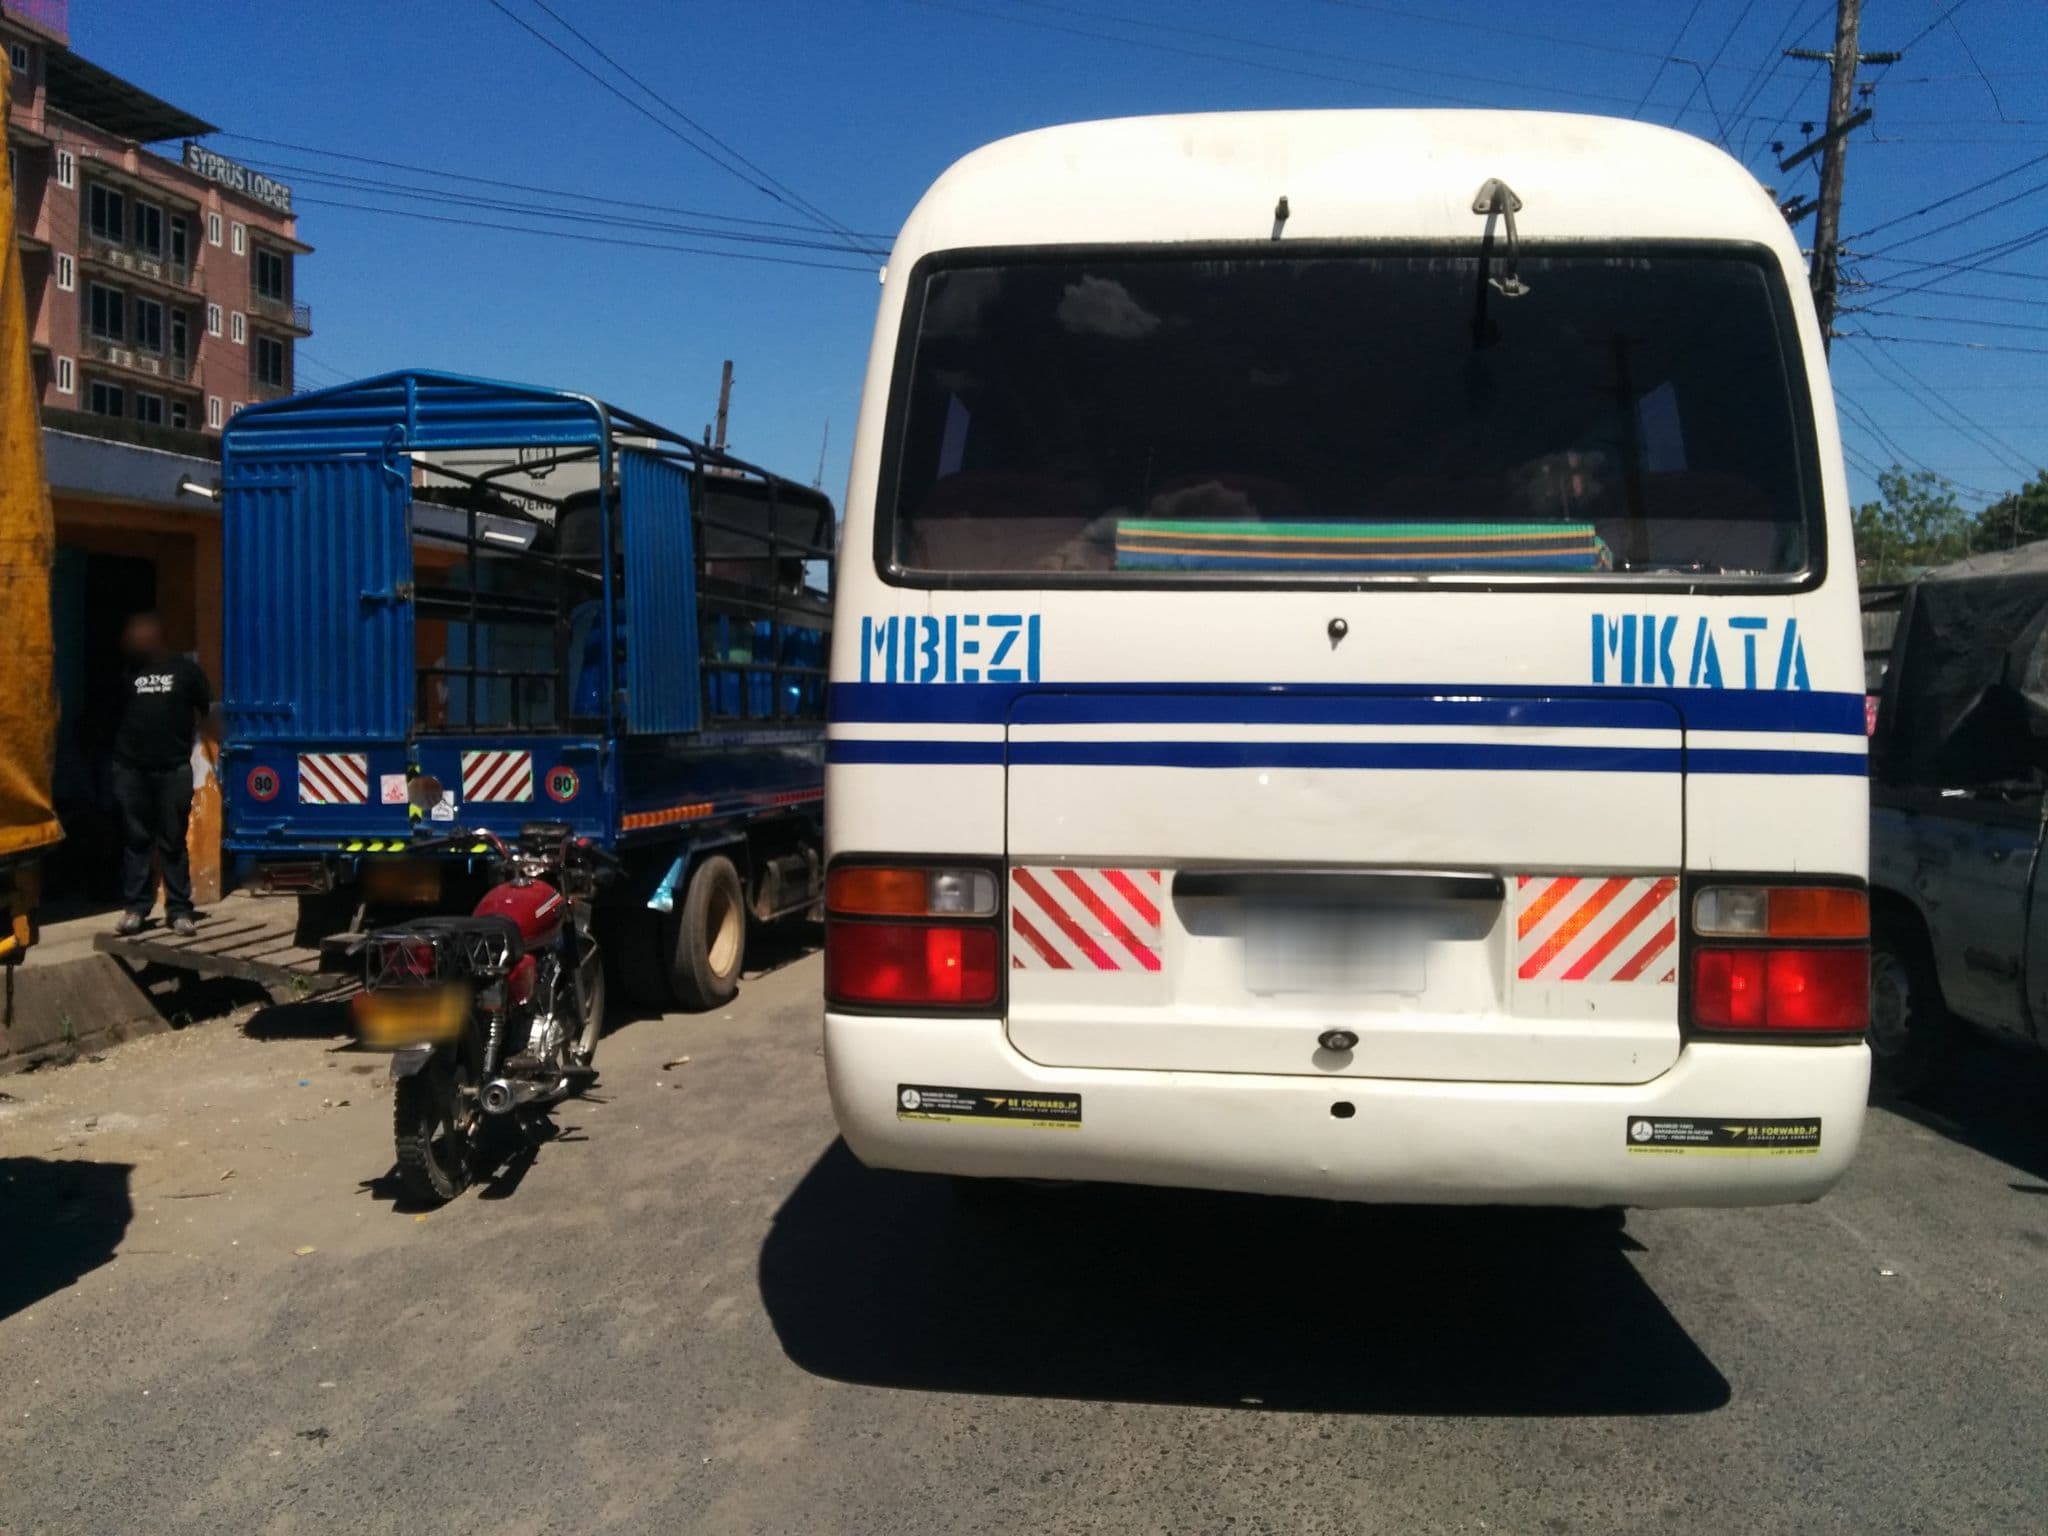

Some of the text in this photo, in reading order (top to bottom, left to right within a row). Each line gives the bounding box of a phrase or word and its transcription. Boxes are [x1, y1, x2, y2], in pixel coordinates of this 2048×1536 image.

[190, 145, 289, 210] SYPRUS LODGE
[860, 614, 1041, 683] MBEZI
[1591, 613, 1811, 691] MKATA
[254, 776, 272, 792] 80
[553, 776, 572, 792] 80
